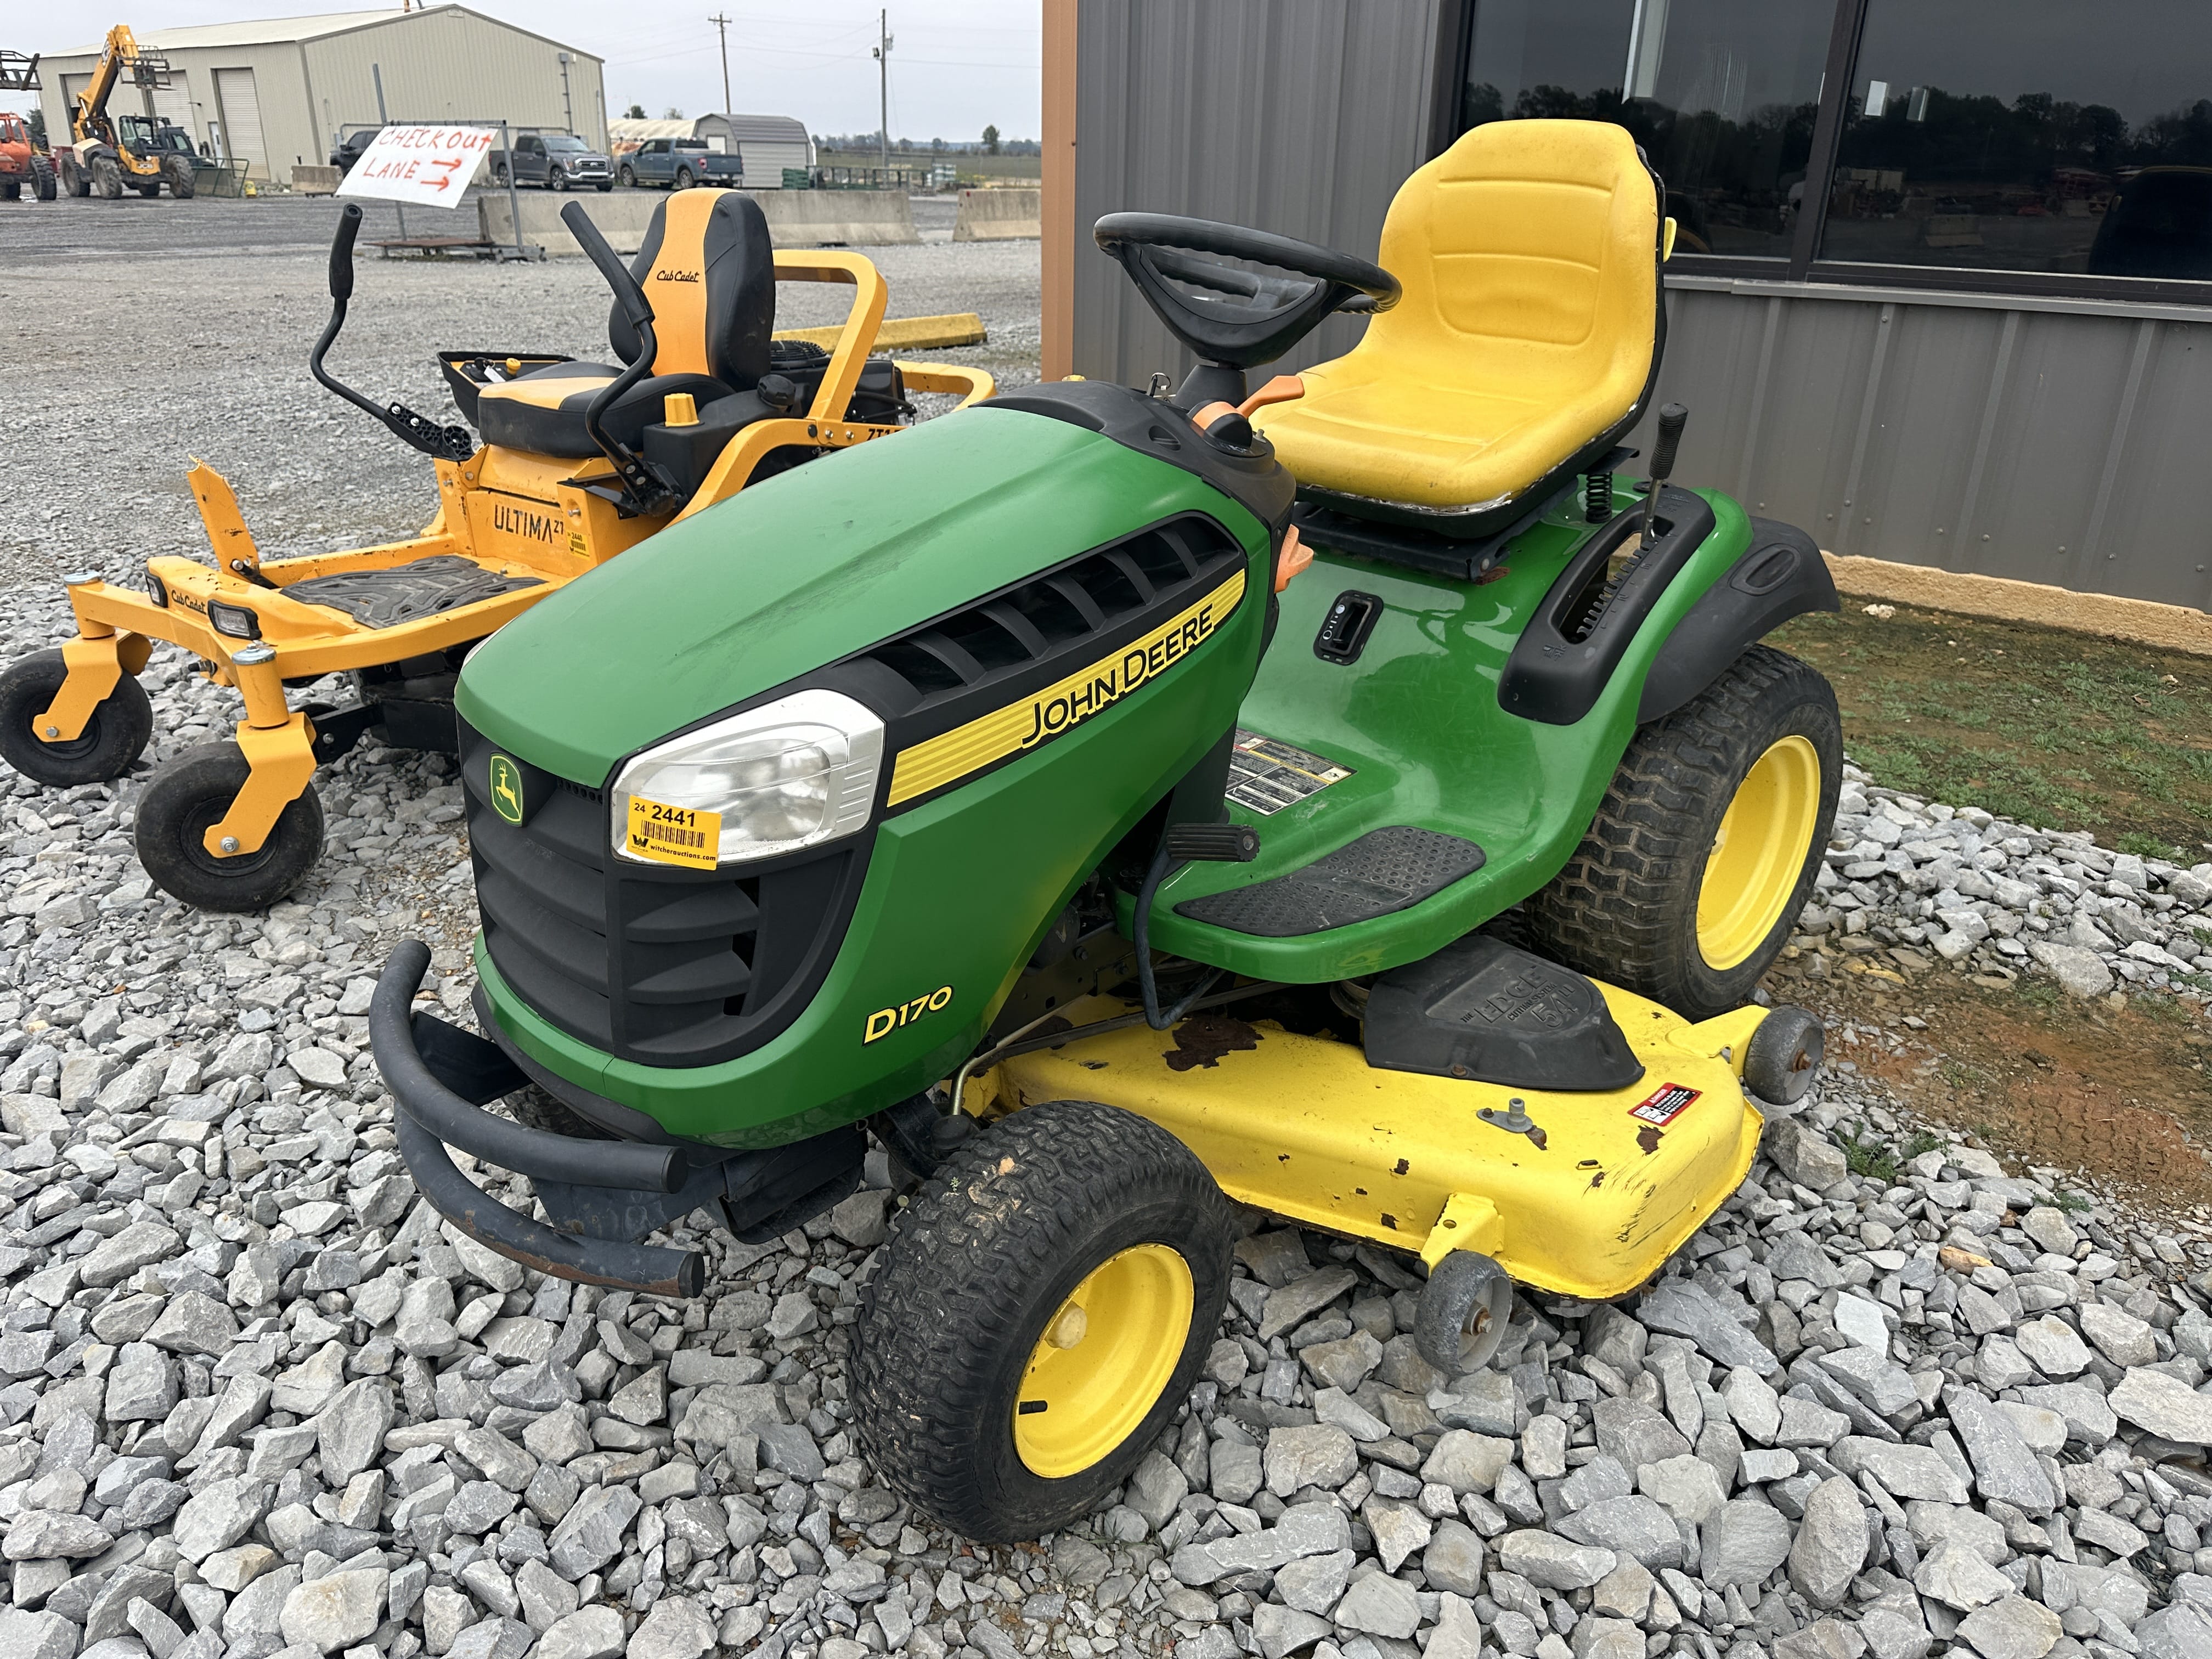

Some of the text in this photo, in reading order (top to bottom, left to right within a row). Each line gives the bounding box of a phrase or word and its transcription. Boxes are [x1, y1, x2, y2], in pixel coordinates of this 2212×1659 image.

[379, 128, 444, 149] CHECK
[363, 157, 420, 179] LANE
[657, 270, 699, 283] Cub Cadet
[494, 504, 552, 544] ULTIMA
[171, 590, 207, 615] Cub Cadet
[1022, 603, 1214, 744] JOHN DEERE
[634, 803, 696, 827] 24 2441
[650, 845, 716, 861] witcherauctions.com
[1460, 969, 1548, 1024] THE EDGE
[863, 985, 953, 1045] D170
